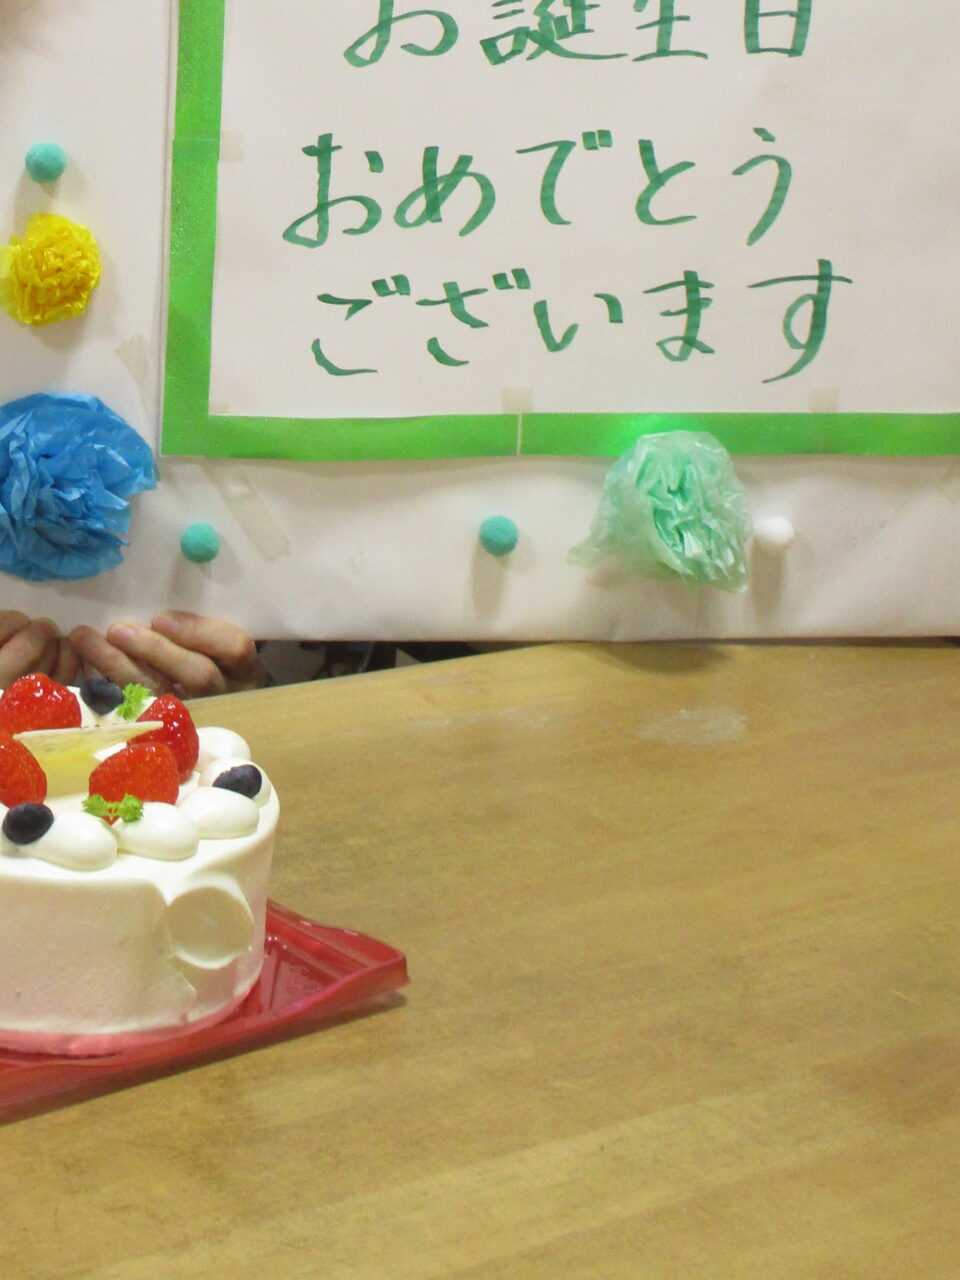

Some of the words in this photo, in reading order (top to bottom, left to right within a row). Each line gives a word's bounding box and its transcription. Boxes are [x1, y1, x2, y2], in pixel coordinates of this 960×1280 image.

[282, 127, 792, 249] おめでとう
[310, 258, 852, 384] ございます
